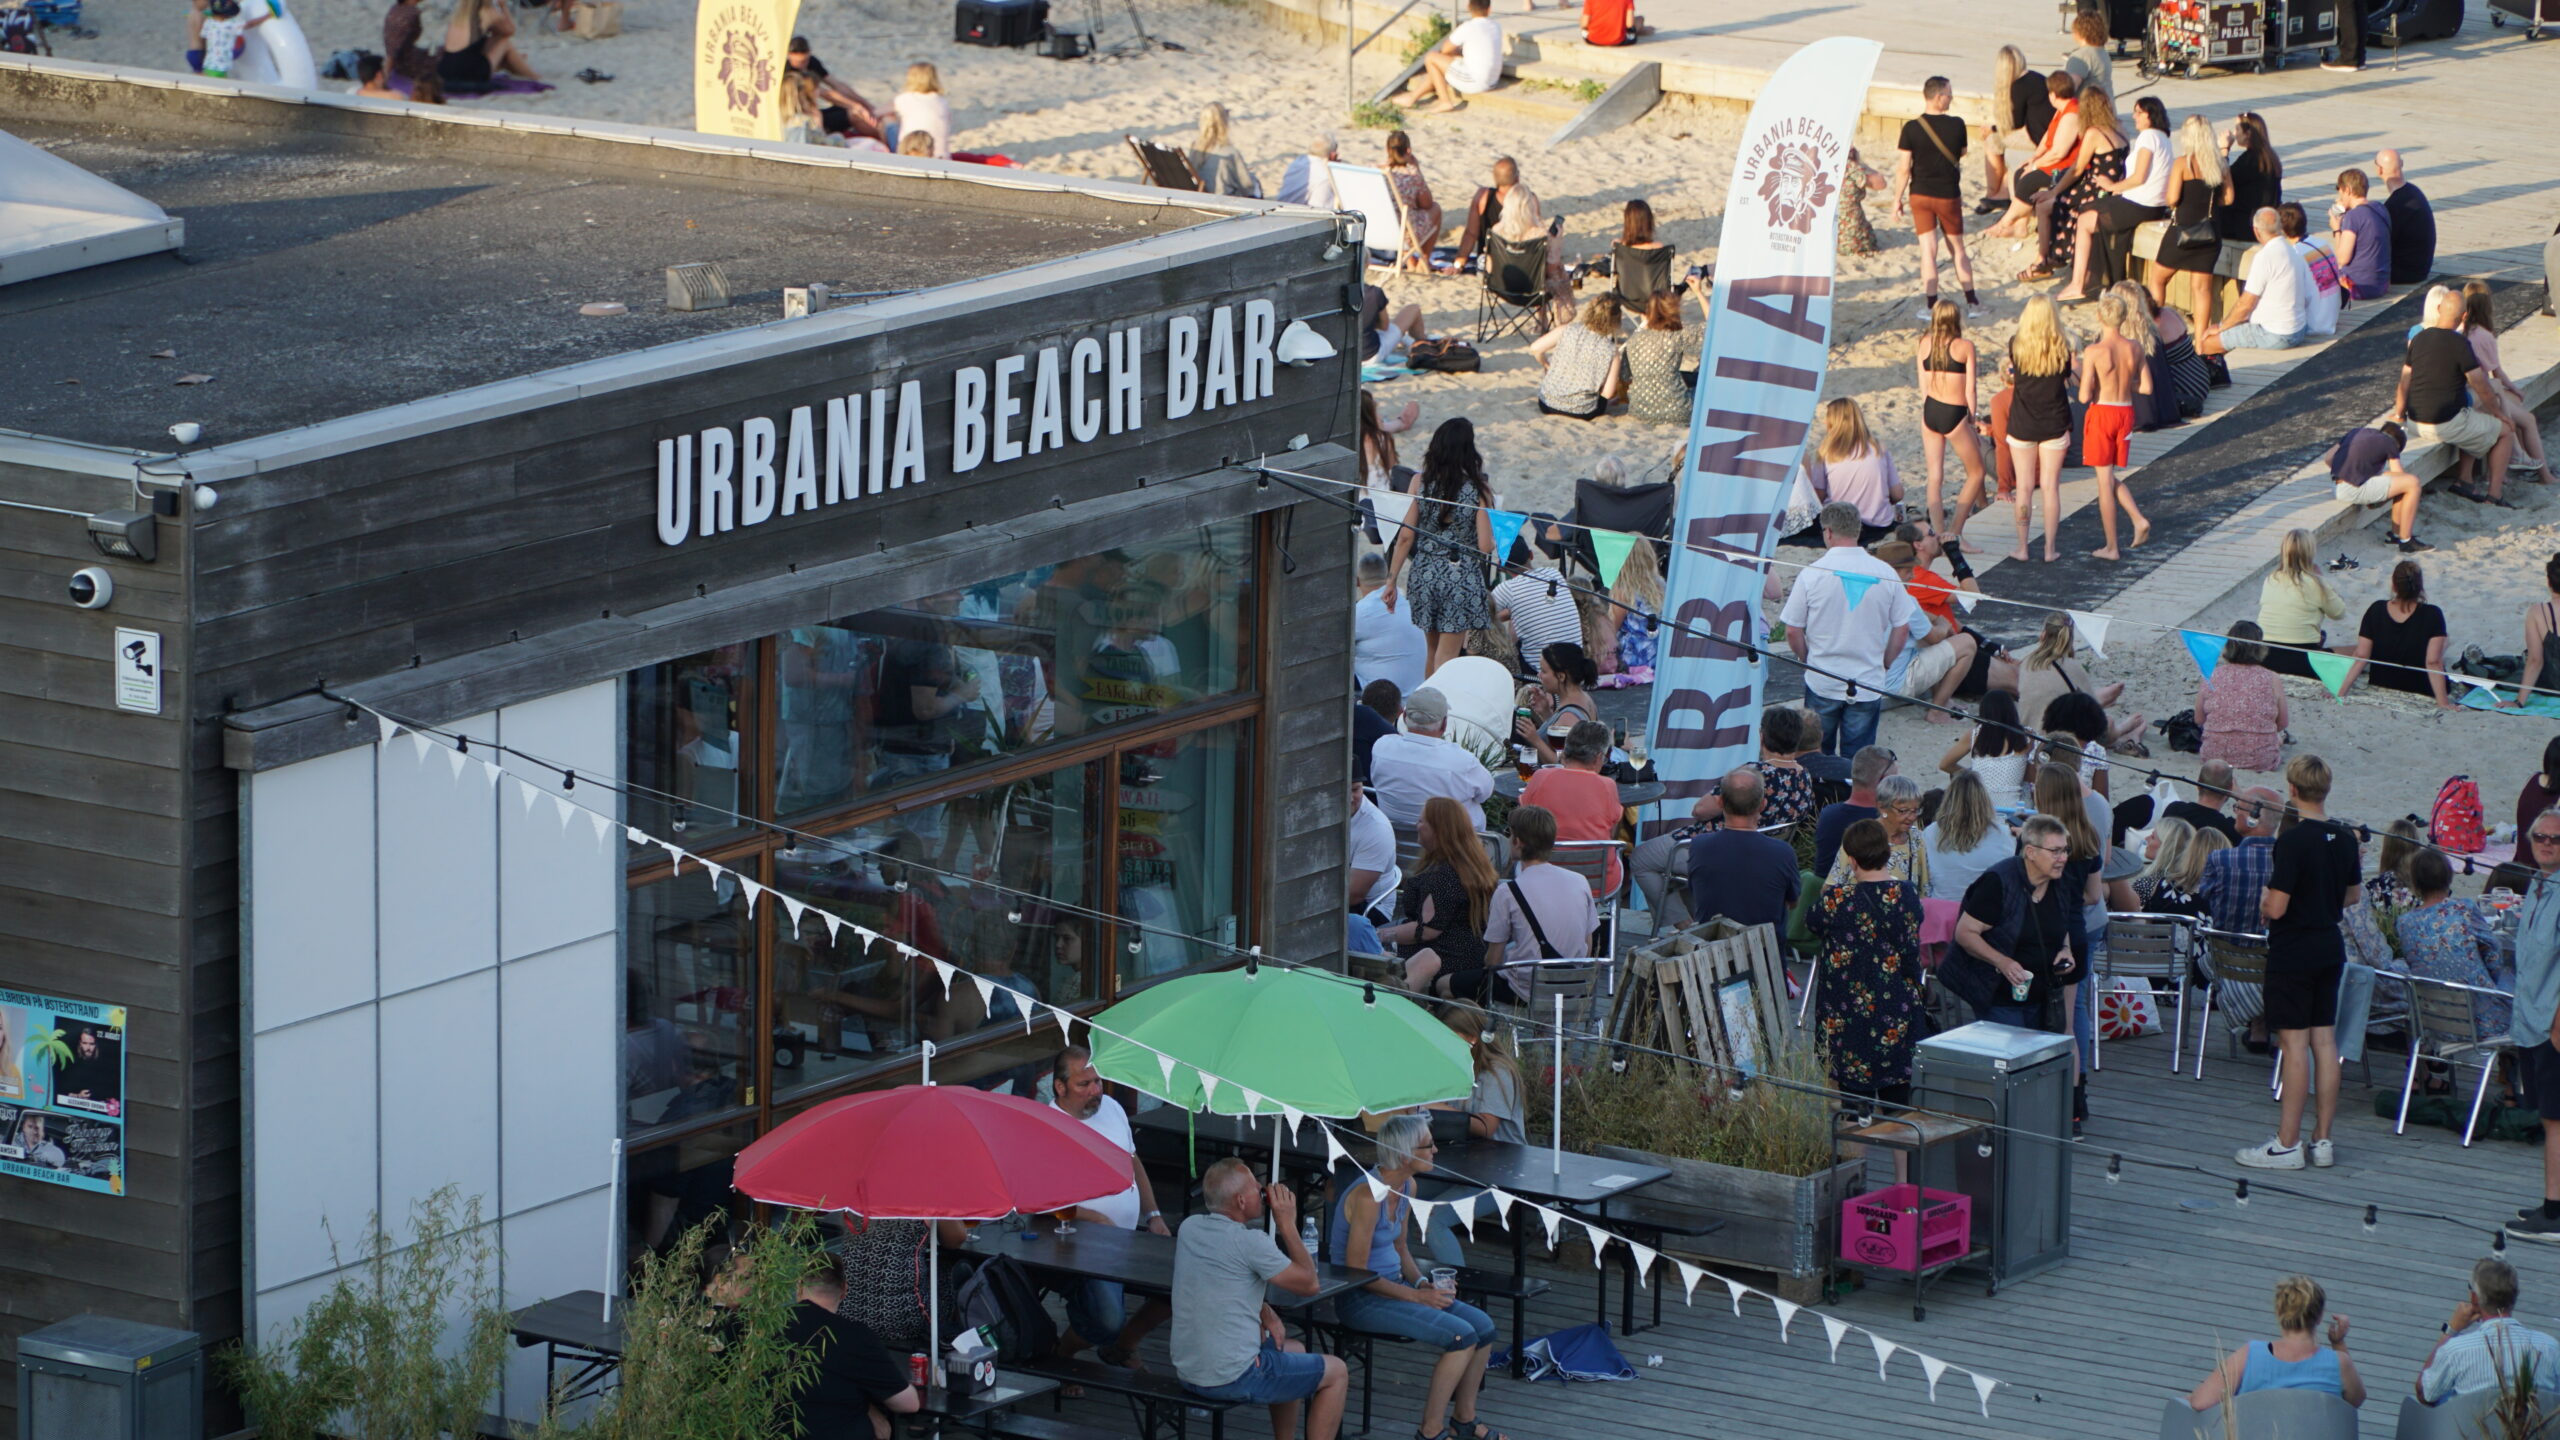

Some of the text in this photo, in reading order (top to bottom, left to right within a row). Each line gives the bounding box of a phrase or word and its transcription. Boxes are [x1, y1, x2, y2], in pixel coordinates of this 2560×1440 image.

[1742, 116, 1841, 182] URBANIA BEACH
[657, 298, 1275, 546] URBANIA BEACH BAR
[1119, 789, 1159, 806] WAII
[1119, 812, 1137, 828] ali
[1124, 858, 1171, 873] SANTA
[1117, 871, 1171, 886] ARBARA
[44, 998, 100, 1019] ØSTERSTRAND
[2, 1162, 70, 1184] URBANIA BEACH BAR
